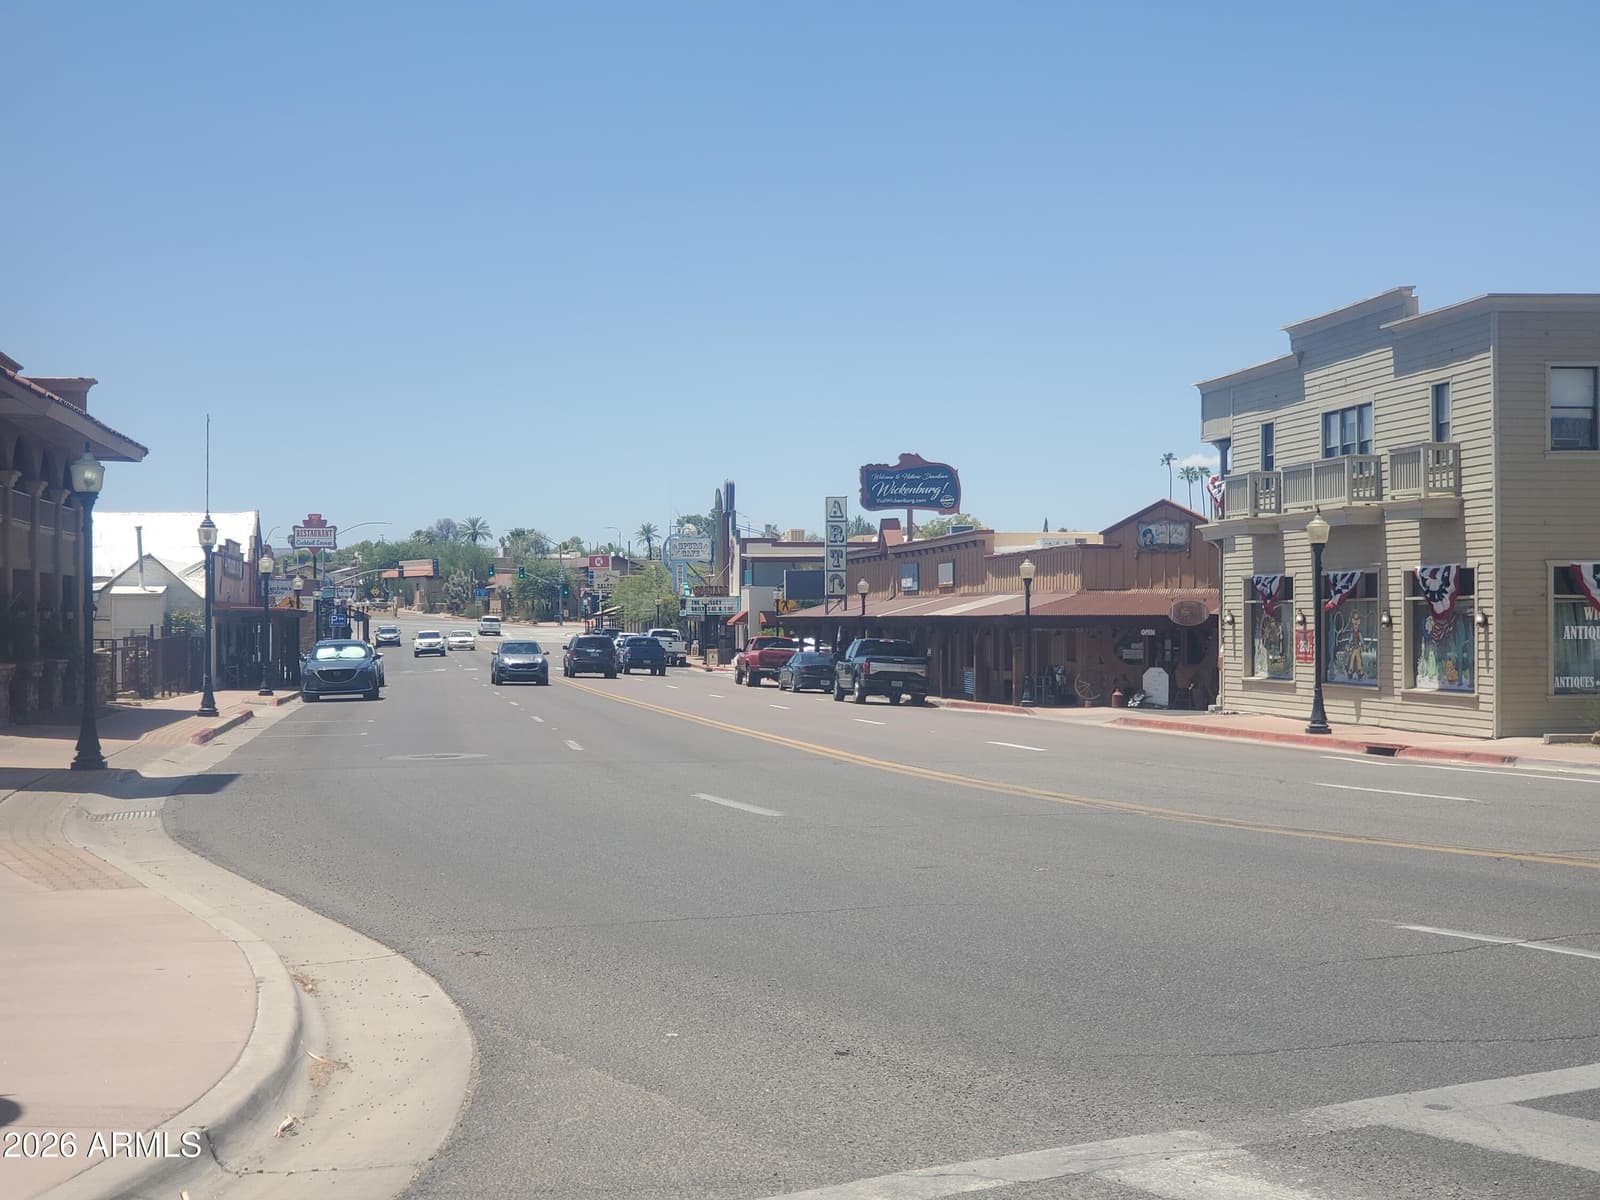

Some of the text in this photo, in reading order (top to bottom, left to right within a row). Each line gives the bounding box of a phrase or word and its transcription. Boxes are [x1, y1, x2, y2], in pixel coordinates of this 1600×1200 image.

[871, 481, 949, 500] Wickenburg!
[829, 500, 845, 568] ART
[1583, 606, 1600, 620] WI
[1554, 676, 1595, 688] ANTIQUES
